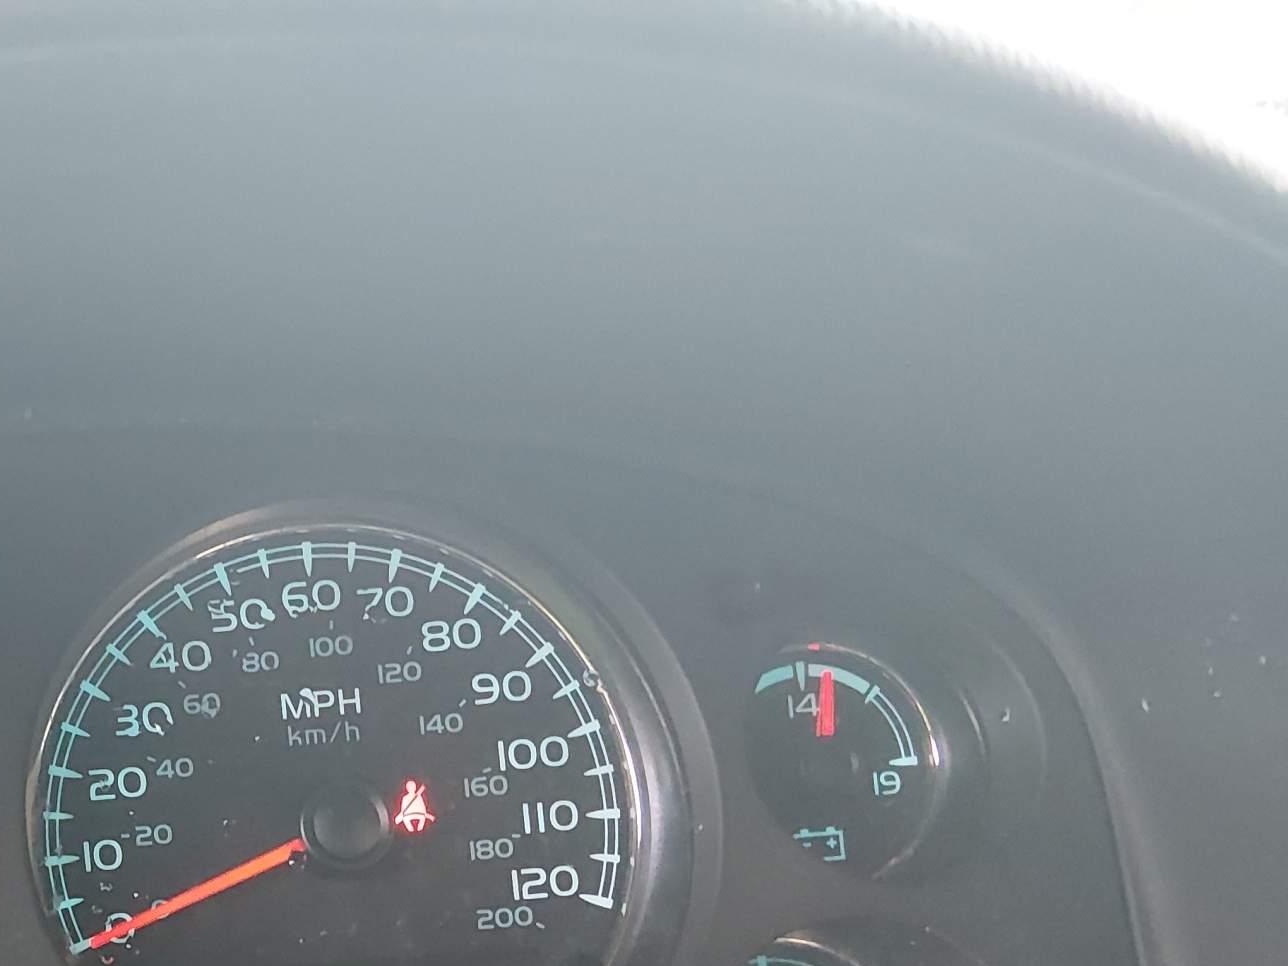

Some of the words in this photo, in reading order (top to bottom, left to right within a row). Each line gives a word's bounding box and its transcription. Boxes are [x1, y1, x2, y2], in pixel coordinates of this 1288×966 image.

[281, 579, 342, 616] 60
[356, 586, 414, 618] 70
[207, 597, 276, 633] 50
[309, 635, 354, 658] 100
[421, 617, 482, 653] 80
[149, 640, 212, 673] 40
[241, 651, 280, 673] 80
[378, 661, 422, 685] 120
[471, 670, 532, 706] 90
[115, 701, 174, 736] 30
[183, 692, 221, 718] 60
[280, 688, 362, 721] MPH
[787, 693, 819, 719] 14
[287, 720, 361, 748] km/h
[419, 712, 463, 736] 140
[155, 757, 194, 779] 40
[497, 735, 570, 772] 100
[88, 766, 147, 801] 20
[463, 775, 508, 799] 160
[872, 771, 902, 796] 19
[521, 800, 579, 835] 110
[135, 823, 173, 847] 20
[469, 838, 514, 862] 180
[82, 839, 124, 873] 10
[511, 865, 580, 901] 120
[476, 906, 534, 931] 200
